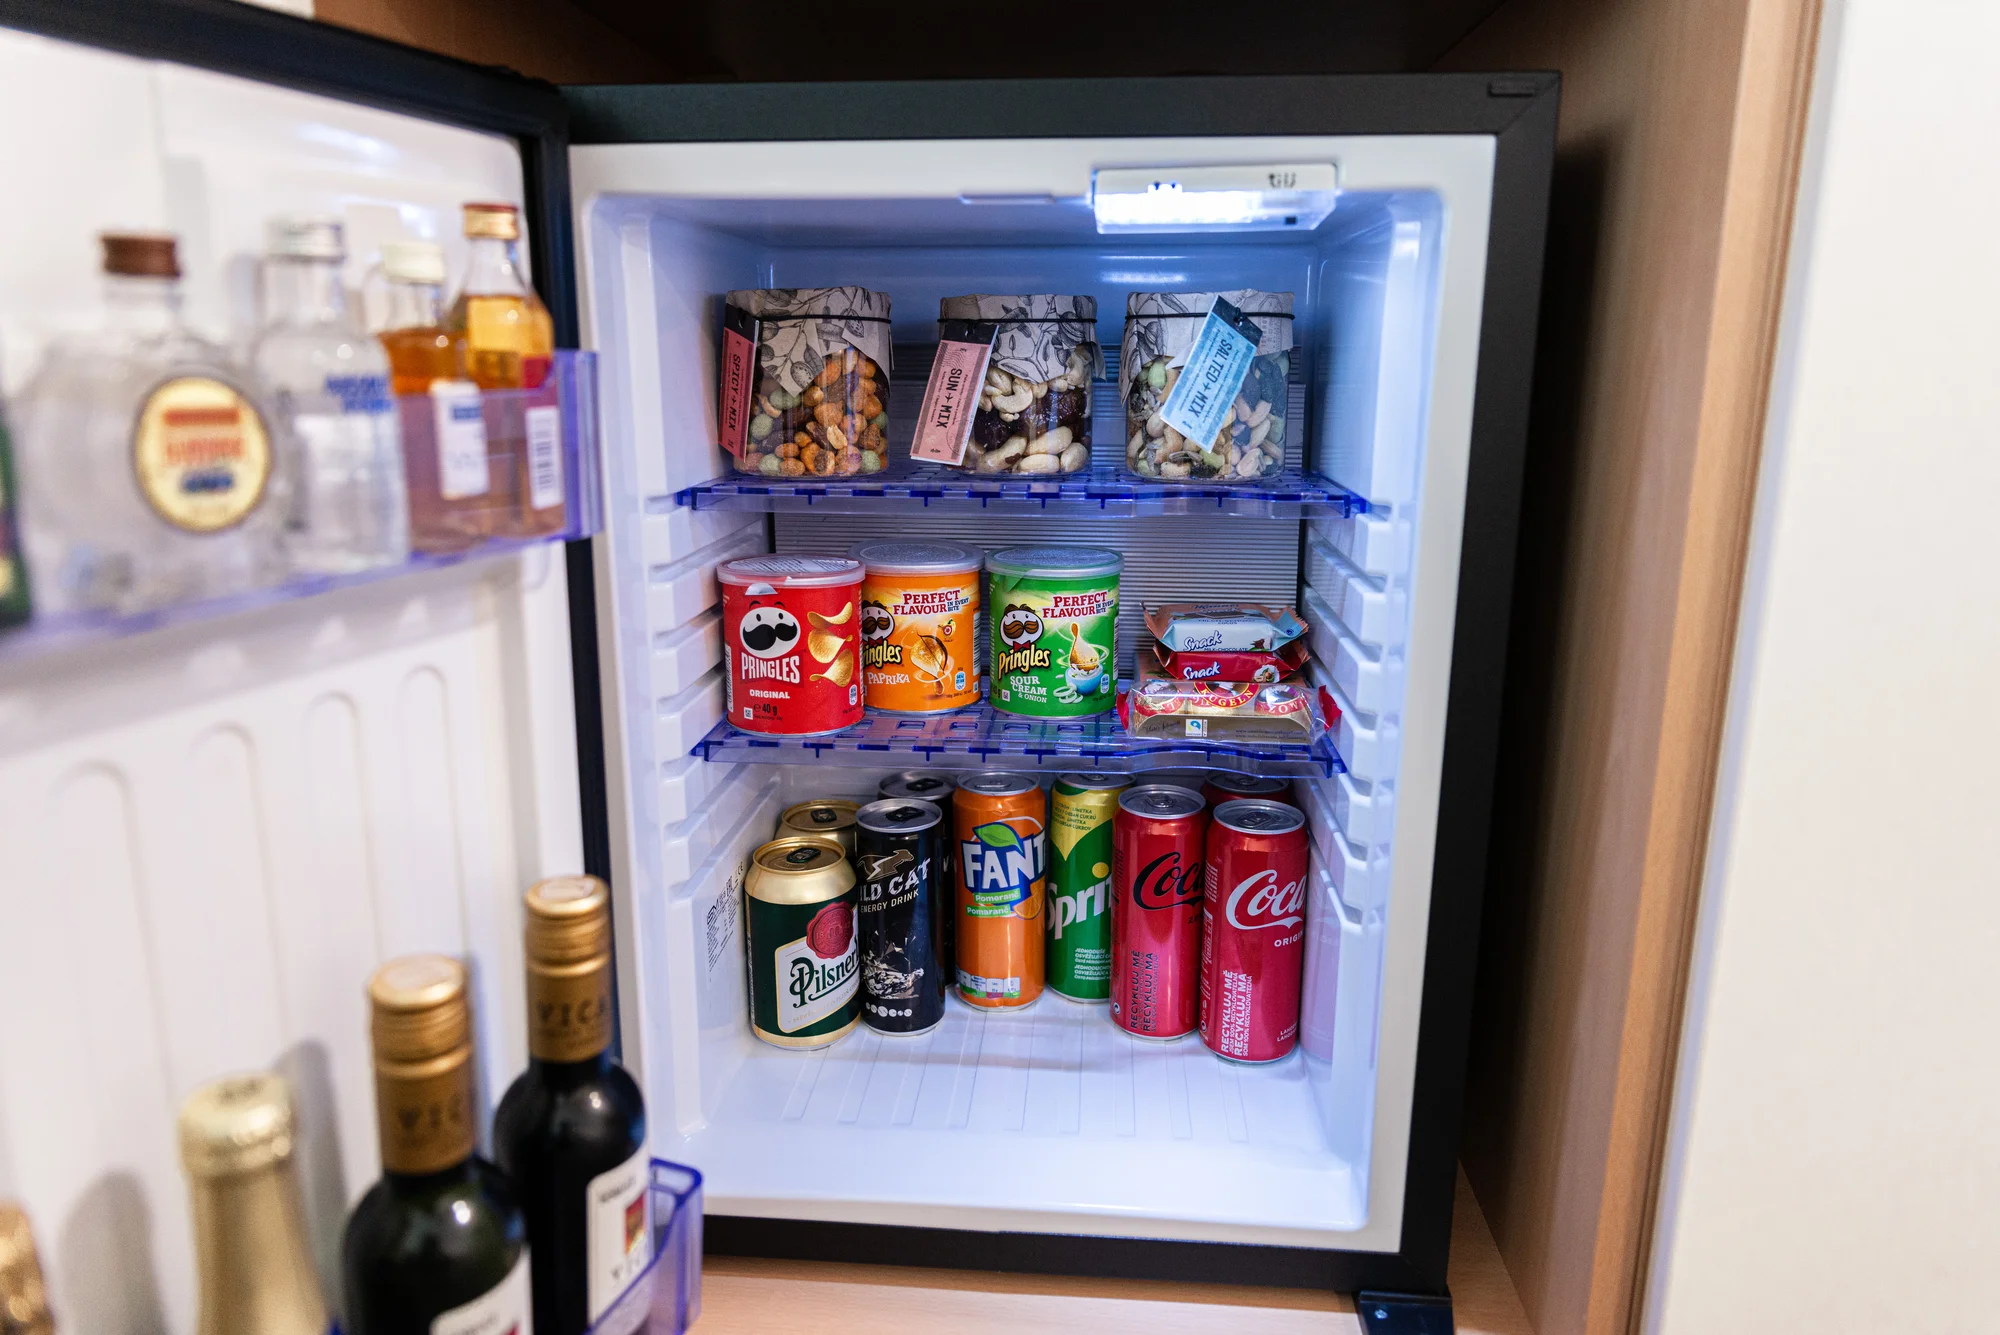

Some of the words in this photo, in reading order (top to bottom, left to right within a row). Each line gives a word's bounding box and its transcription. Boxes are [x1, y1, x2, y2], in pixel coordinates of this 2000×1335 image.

[1207, 339, 1233, 384] SALTED
[731, 353, 741, 396] SPICY
[946, 368, 962, 391] SUN
[1188, 390, 1208, 418] MIX
[727, 405, 738, 432] MIX
[936, 405, 952, 429] MIX
[902, 590, 960, 605] PERFECT
[1053, 591, 1107, 608] PERFECT
[893, 603, 948, 615] FLAVOUR
[1042, 606, 1096, 618] FLAVOUR
[1183, 630, 1222, 652] Snack
[741, 652, 800, 684] PRINGLES
[998, 643, 1051, 679] Pringles
[1183, 661, 1221, 680] Snack
[866, 671, 910, 685] PAPRIKA
[1010, 675, 1041, 685] SOUR
[749, 689, 790, 699] ORIGINAL
[1012, 683, 1047, 696] CREAM
[1024, 693, 1047, 703] ONION
[1201, 688, 1254, 707] KUGELN
[762, 703, 771, 713] 40
[772, 705, 778, 716] g
[962, 830, 1045, 889] FANT
[888, 857, 931, 896] CAT
[860, 901, 888, 913] ENERGY
[890, 888, 919, 907] DRINK
[1145, 952, 1153, 971] MA
[788, 950, 857, 1009] Pilsner
[1223, 969, 1233, 989] MĚ
[1237, 973, 1247, 992] MA
[1130, 971, 1140, 1029] RECYKLUJ
[1143, 973, 1153, 1032] RECYKLUJ
[1221, 991, 1232, 1053] RECYKLUJ
[1234, 994, 1246, 1056] RECYKLUJ
